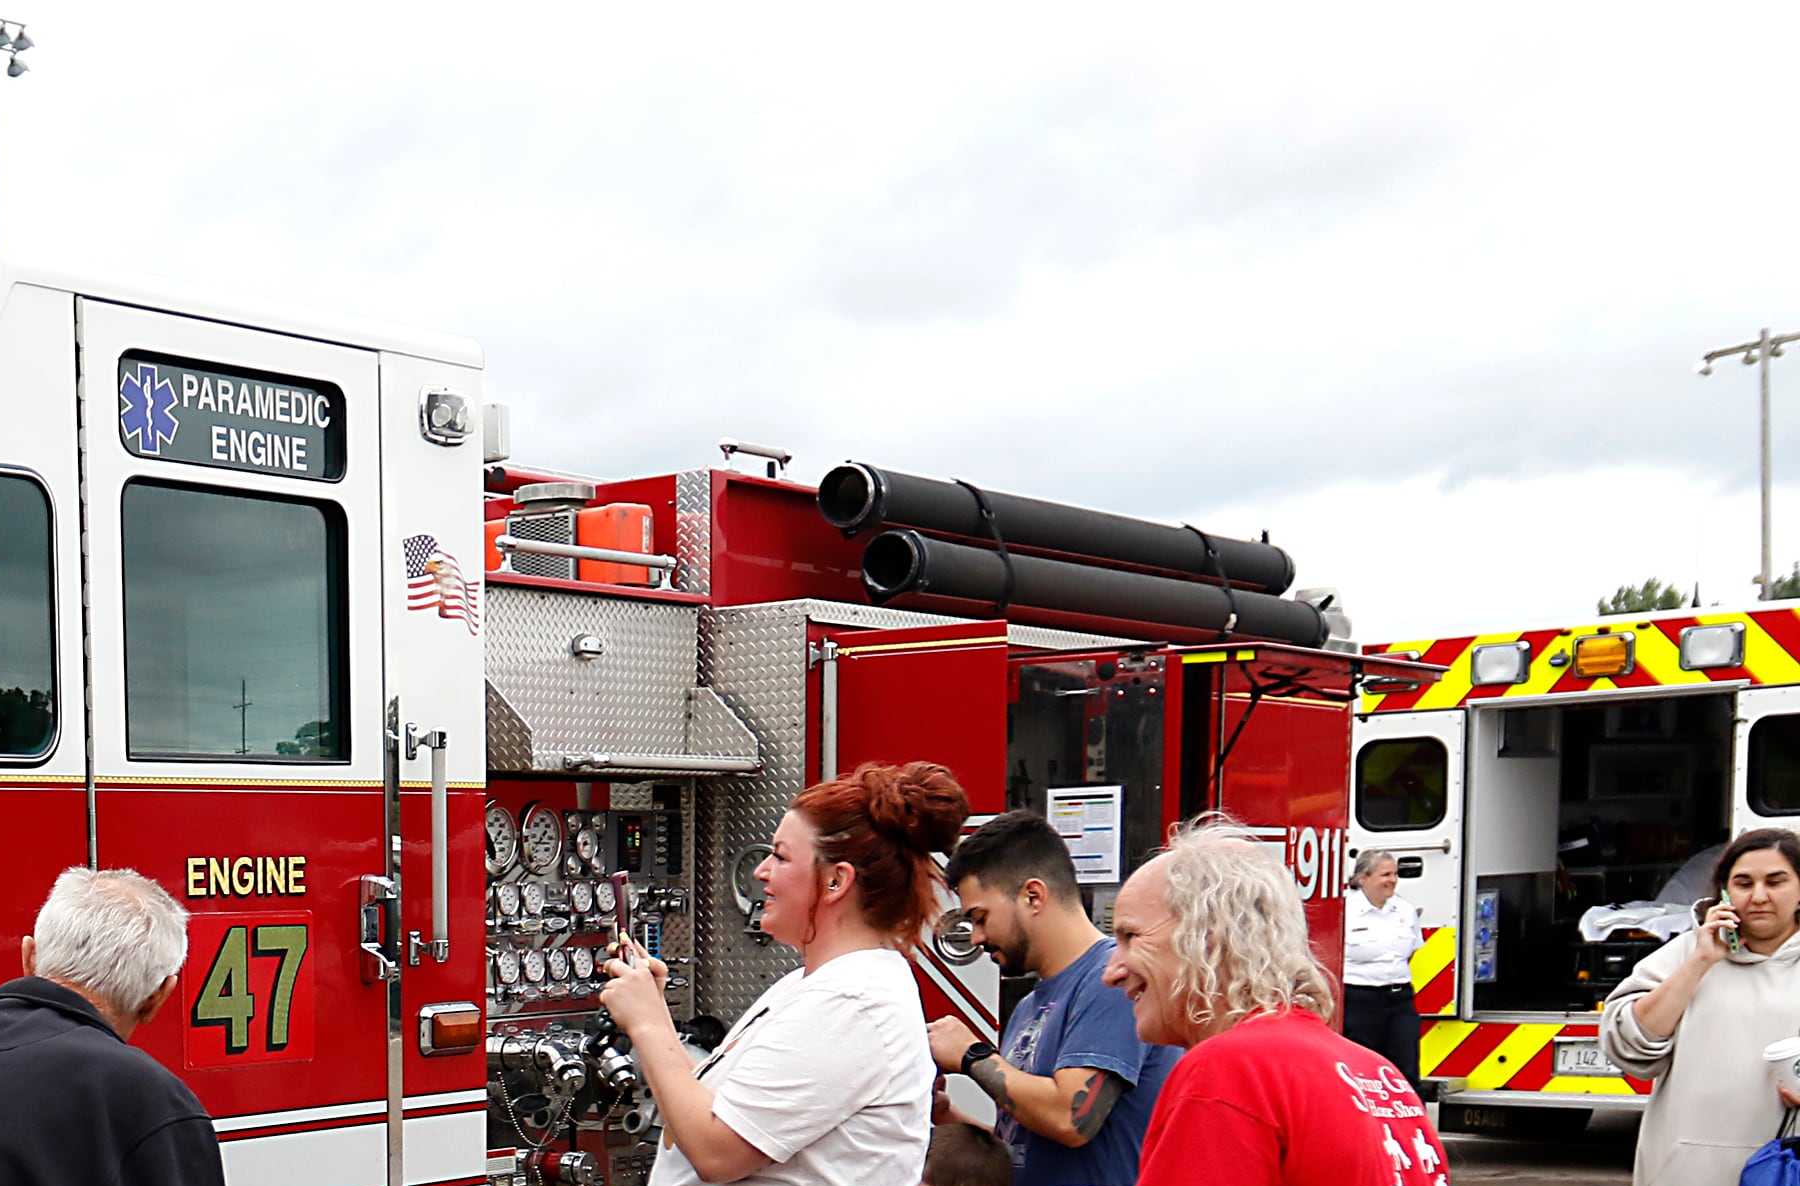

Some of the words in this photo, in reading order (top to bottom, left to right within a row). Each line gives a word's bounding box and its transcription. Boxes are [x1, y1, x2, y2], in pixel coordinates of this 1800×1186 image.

[182, 373, 331, 428] PARAMEDIC
[212, 425, 308, 471] ENGINE
[187, 856, 307, 897] ENGINE
[1297, 826, 1341, 902] 911
[192, 924, 308, 1055] 47
